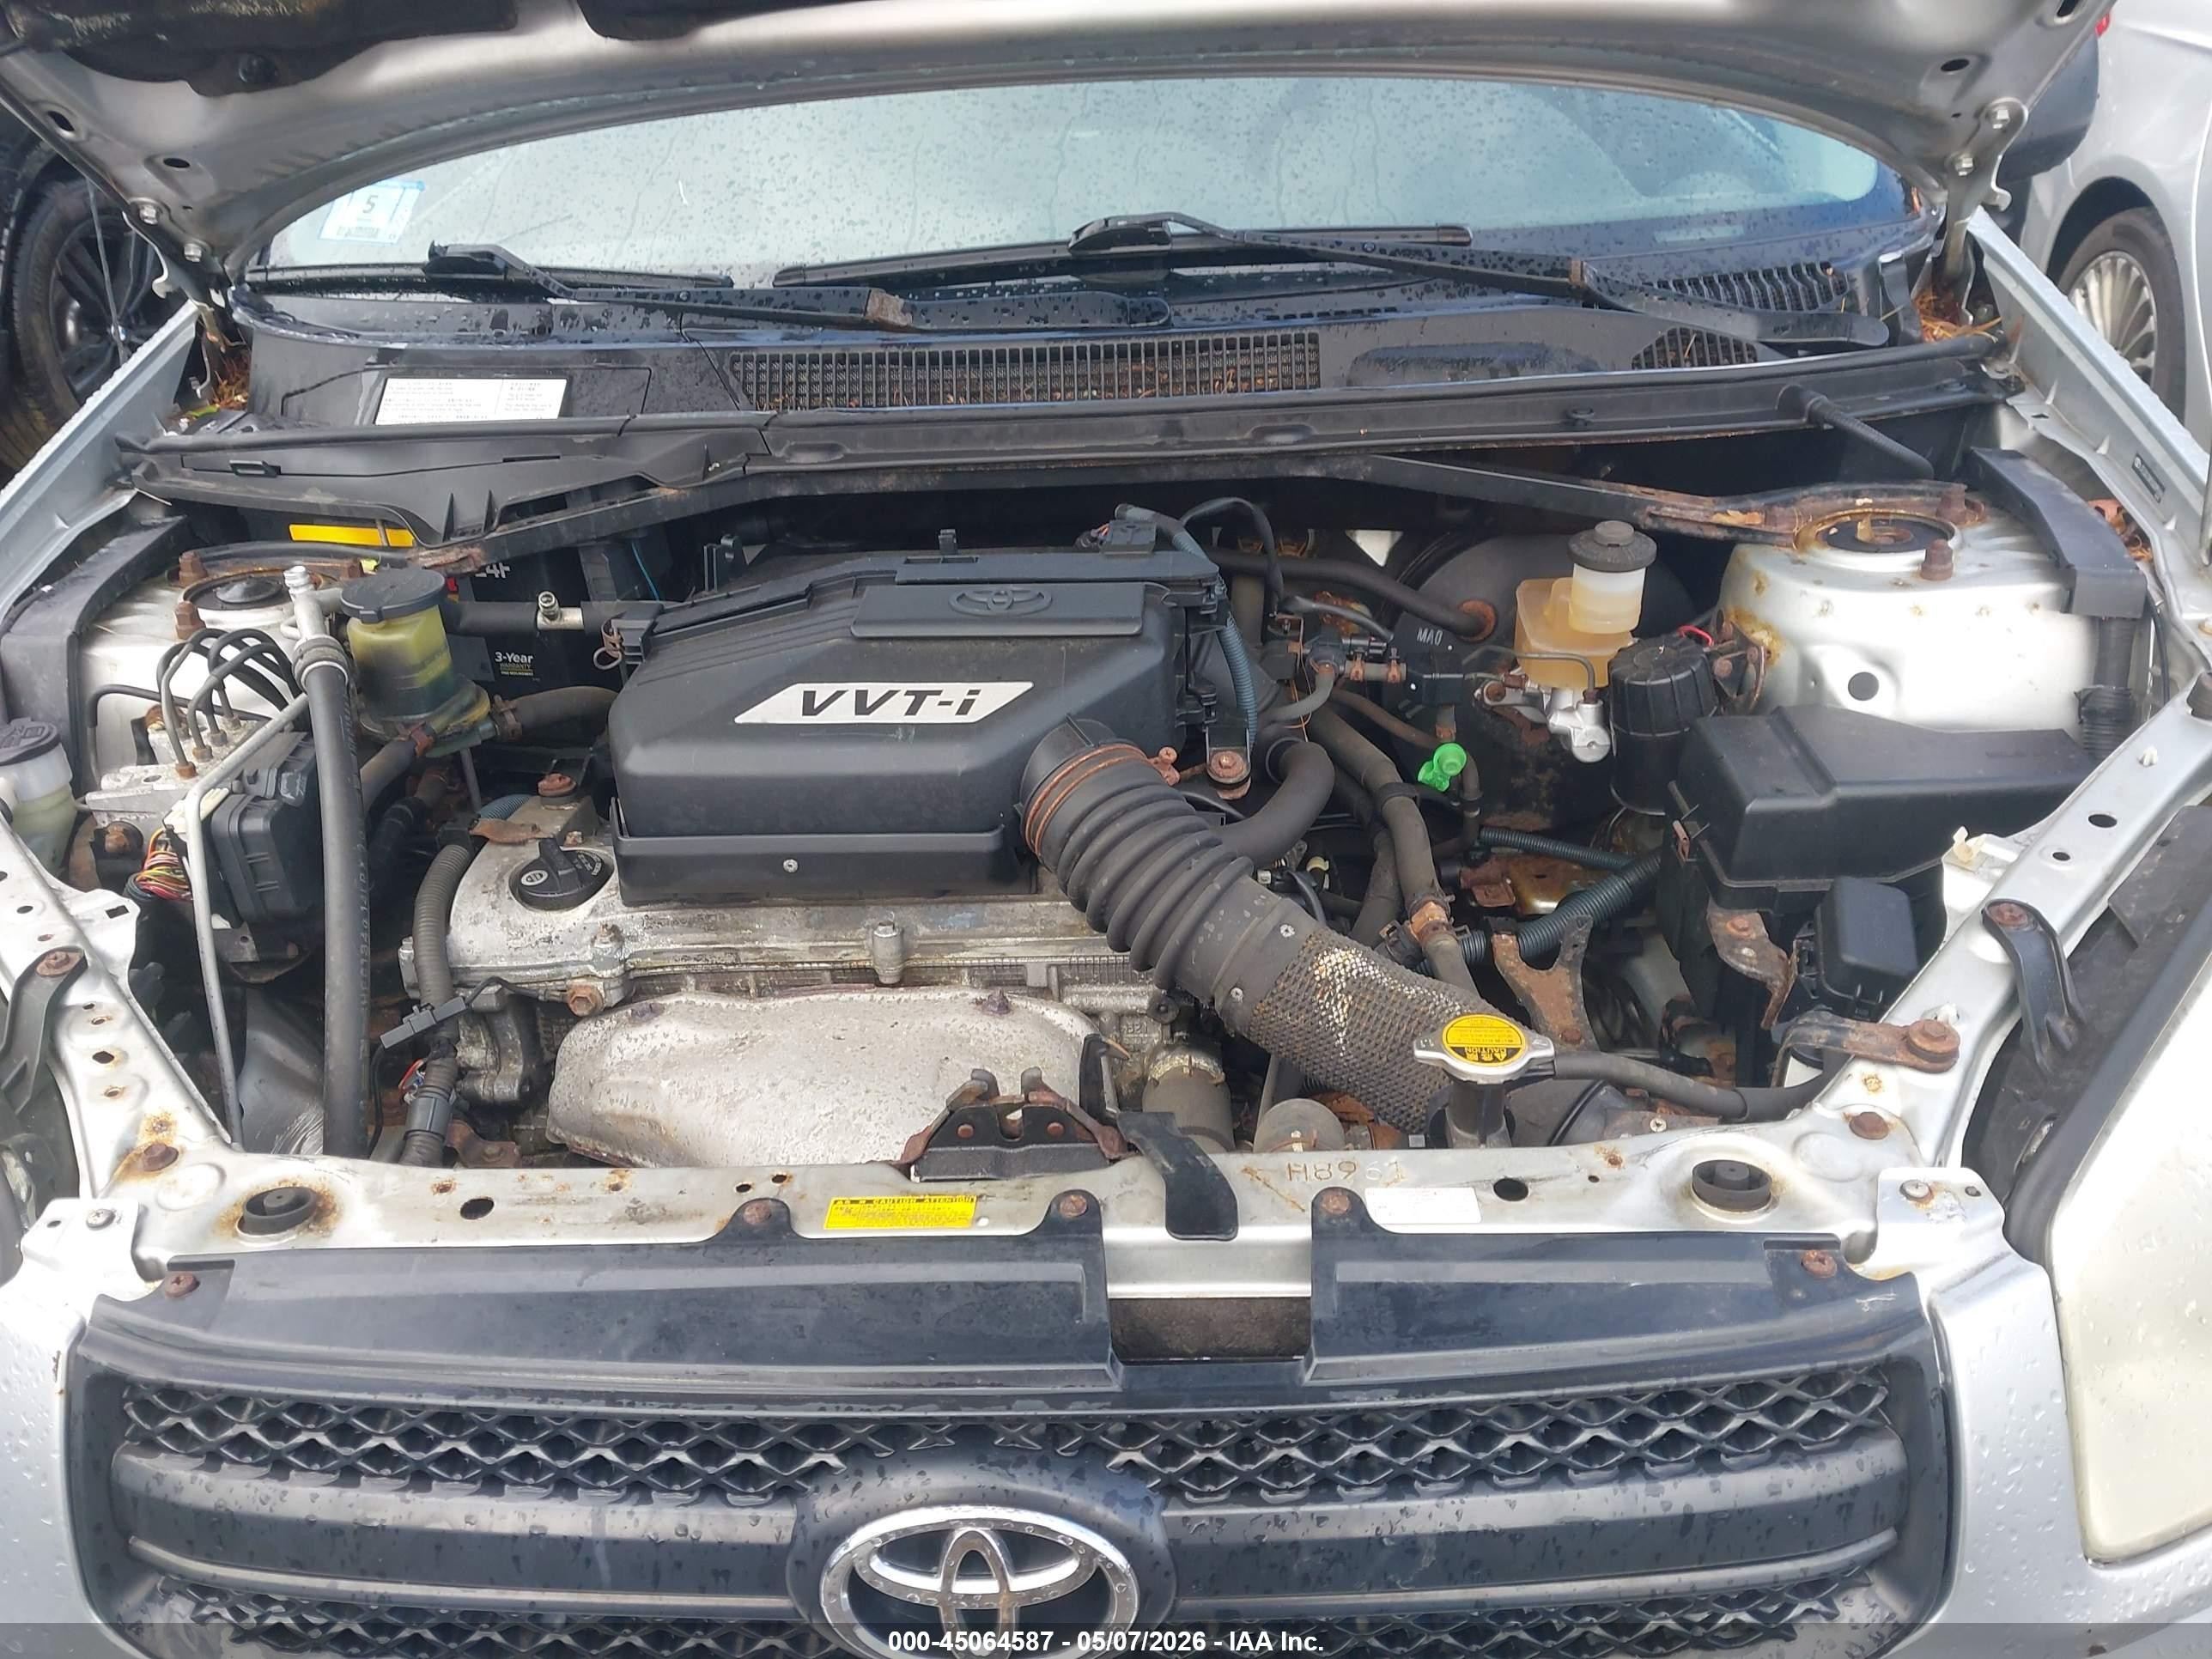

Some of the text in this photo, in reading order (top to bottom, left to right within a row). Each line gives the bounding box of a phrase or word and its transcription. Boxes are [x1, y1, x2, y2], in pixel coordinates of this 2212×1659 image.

[362, 195, 379, 214] 5
[475, 562, 511, 579] 4F
[495, 651, 534, 664] 3-Year
[802, 689, 981, 717] VVT-i
